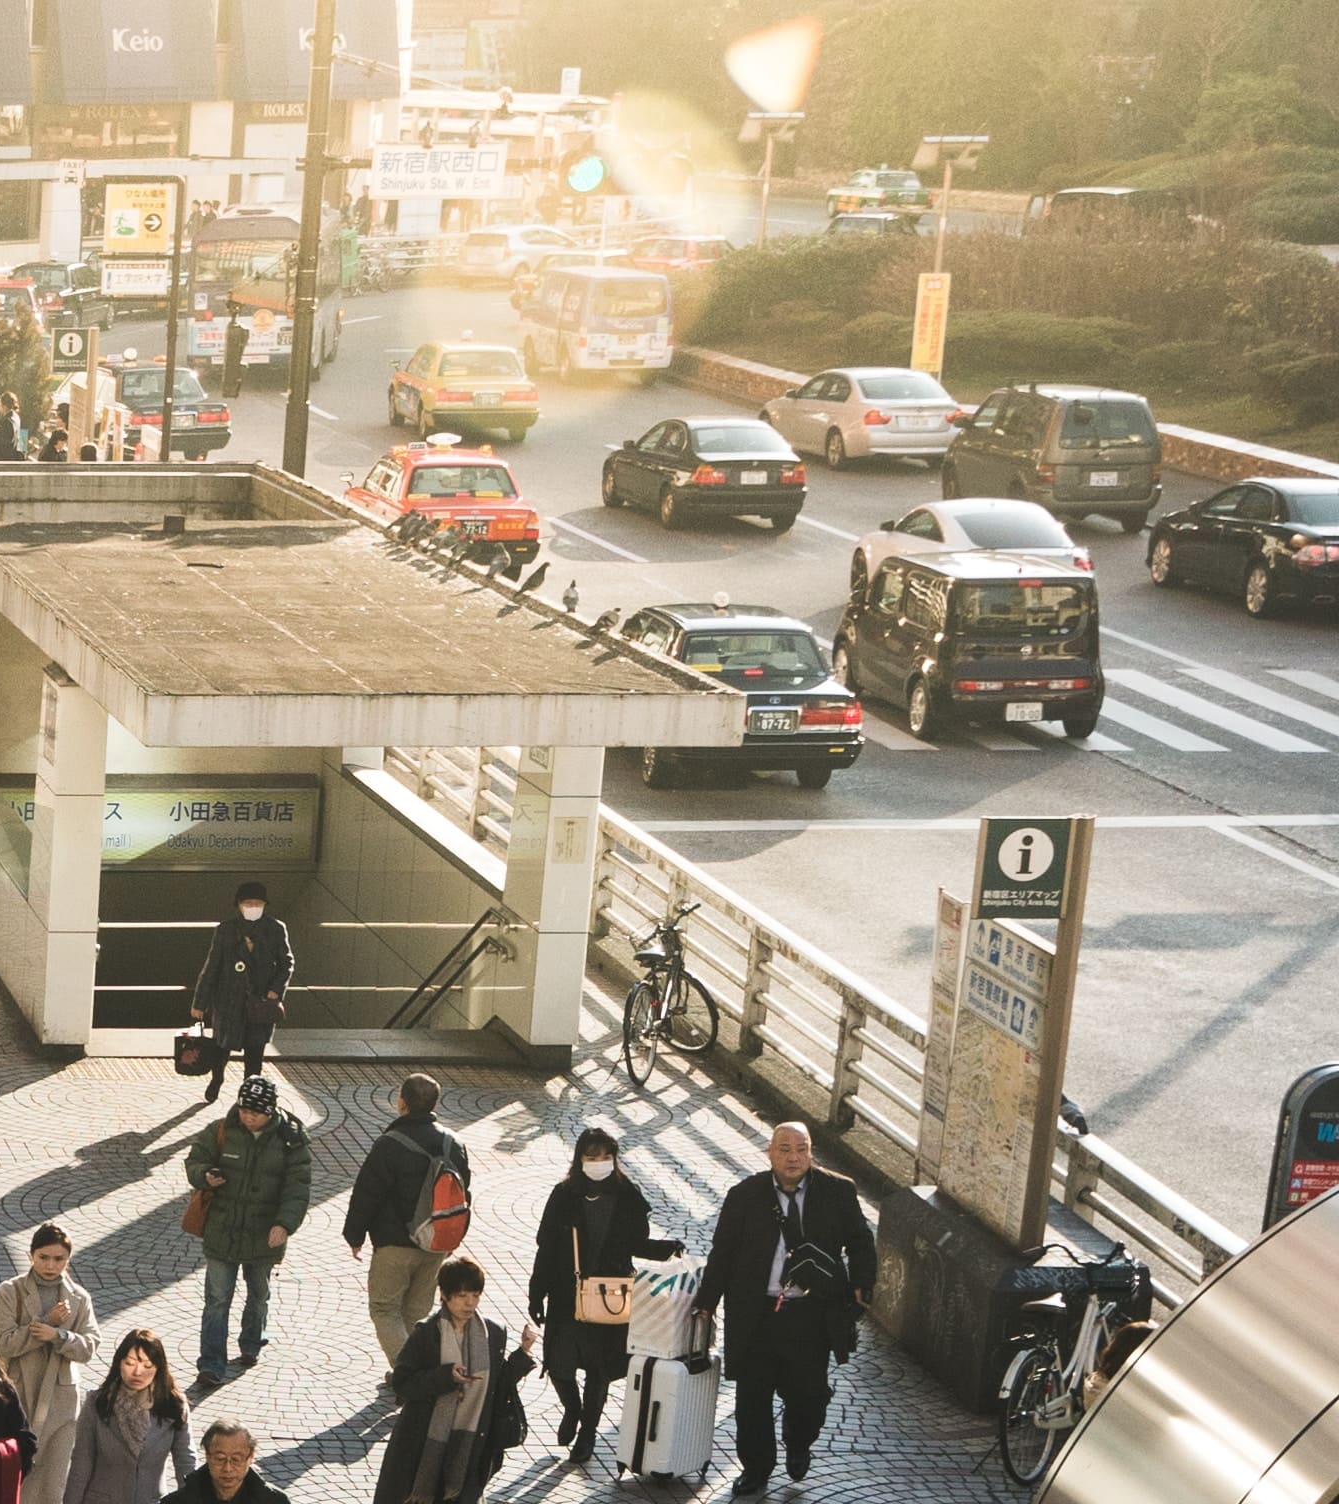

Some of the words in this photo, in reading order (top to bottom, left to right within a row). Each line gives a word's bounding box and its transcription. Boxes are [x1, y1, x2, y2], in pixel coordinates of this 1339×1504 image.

[111, 28, 165, 53] Keio
[379, 151, 499, 175] 新宿駅西口
[380, 177, 425, 192] Shinjuku
[169, 800, 295, 824] 小田急百貨店
[168, 833, 204, 850] Odakyu
[209, 833, 266, 850] Department
[267, 833, 294, 848] Store
